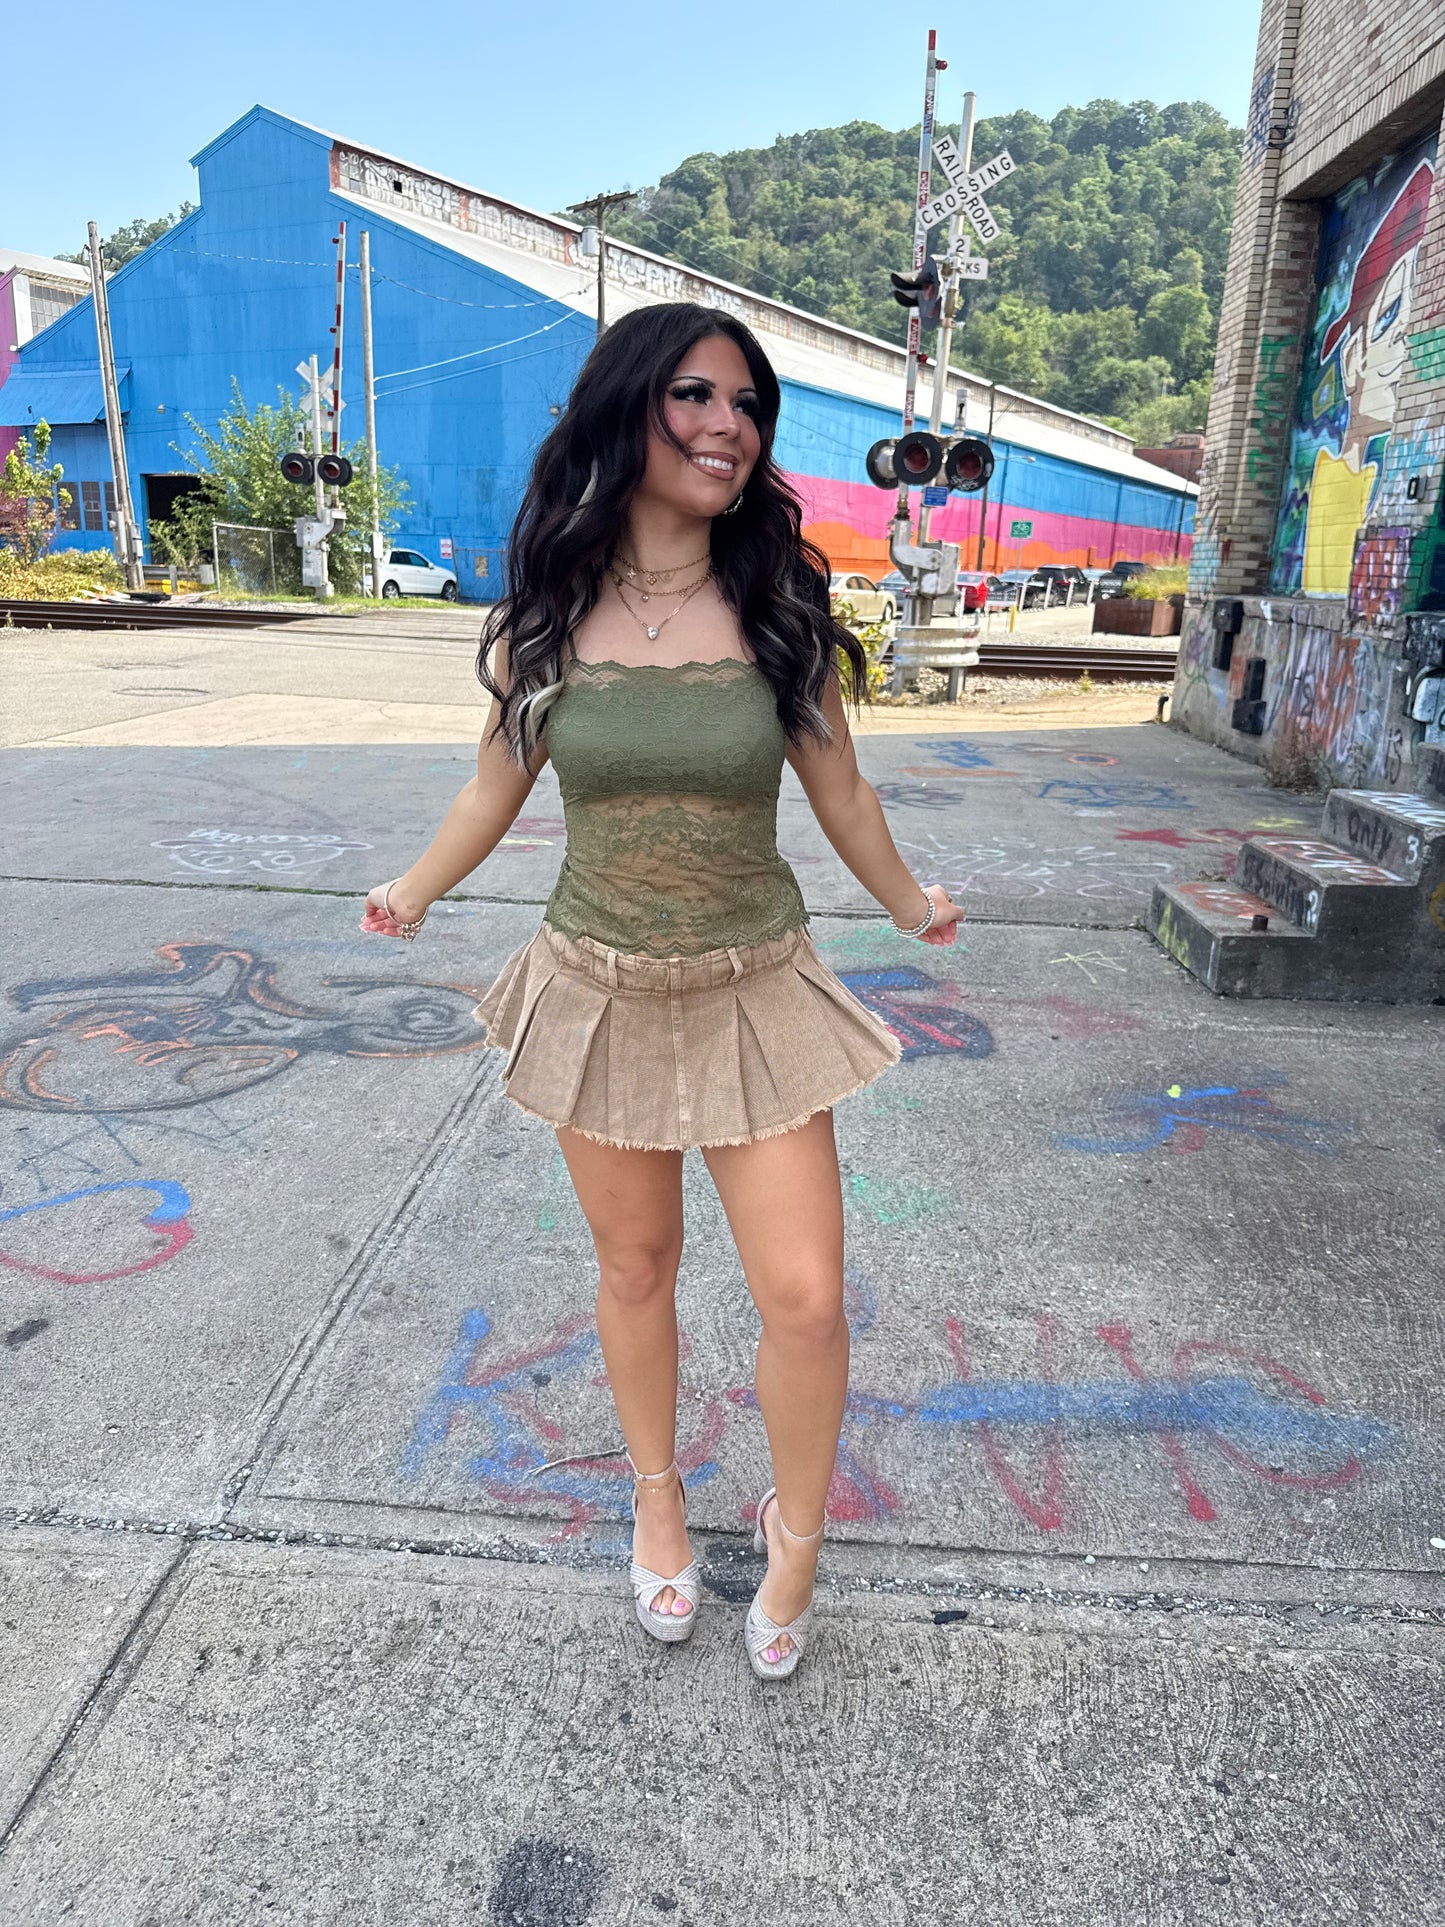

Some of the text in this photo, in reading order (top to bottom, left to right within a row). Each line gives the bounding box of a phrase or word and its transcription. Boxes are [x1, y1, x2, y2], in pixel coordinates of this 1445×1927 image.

[921, 156, 1012, 224] CROSSING
[936, 140, 995, 239] RAIL ROAD
[955, 238, 965, 253] 2
[1405, 834, 1419, 865] 3
